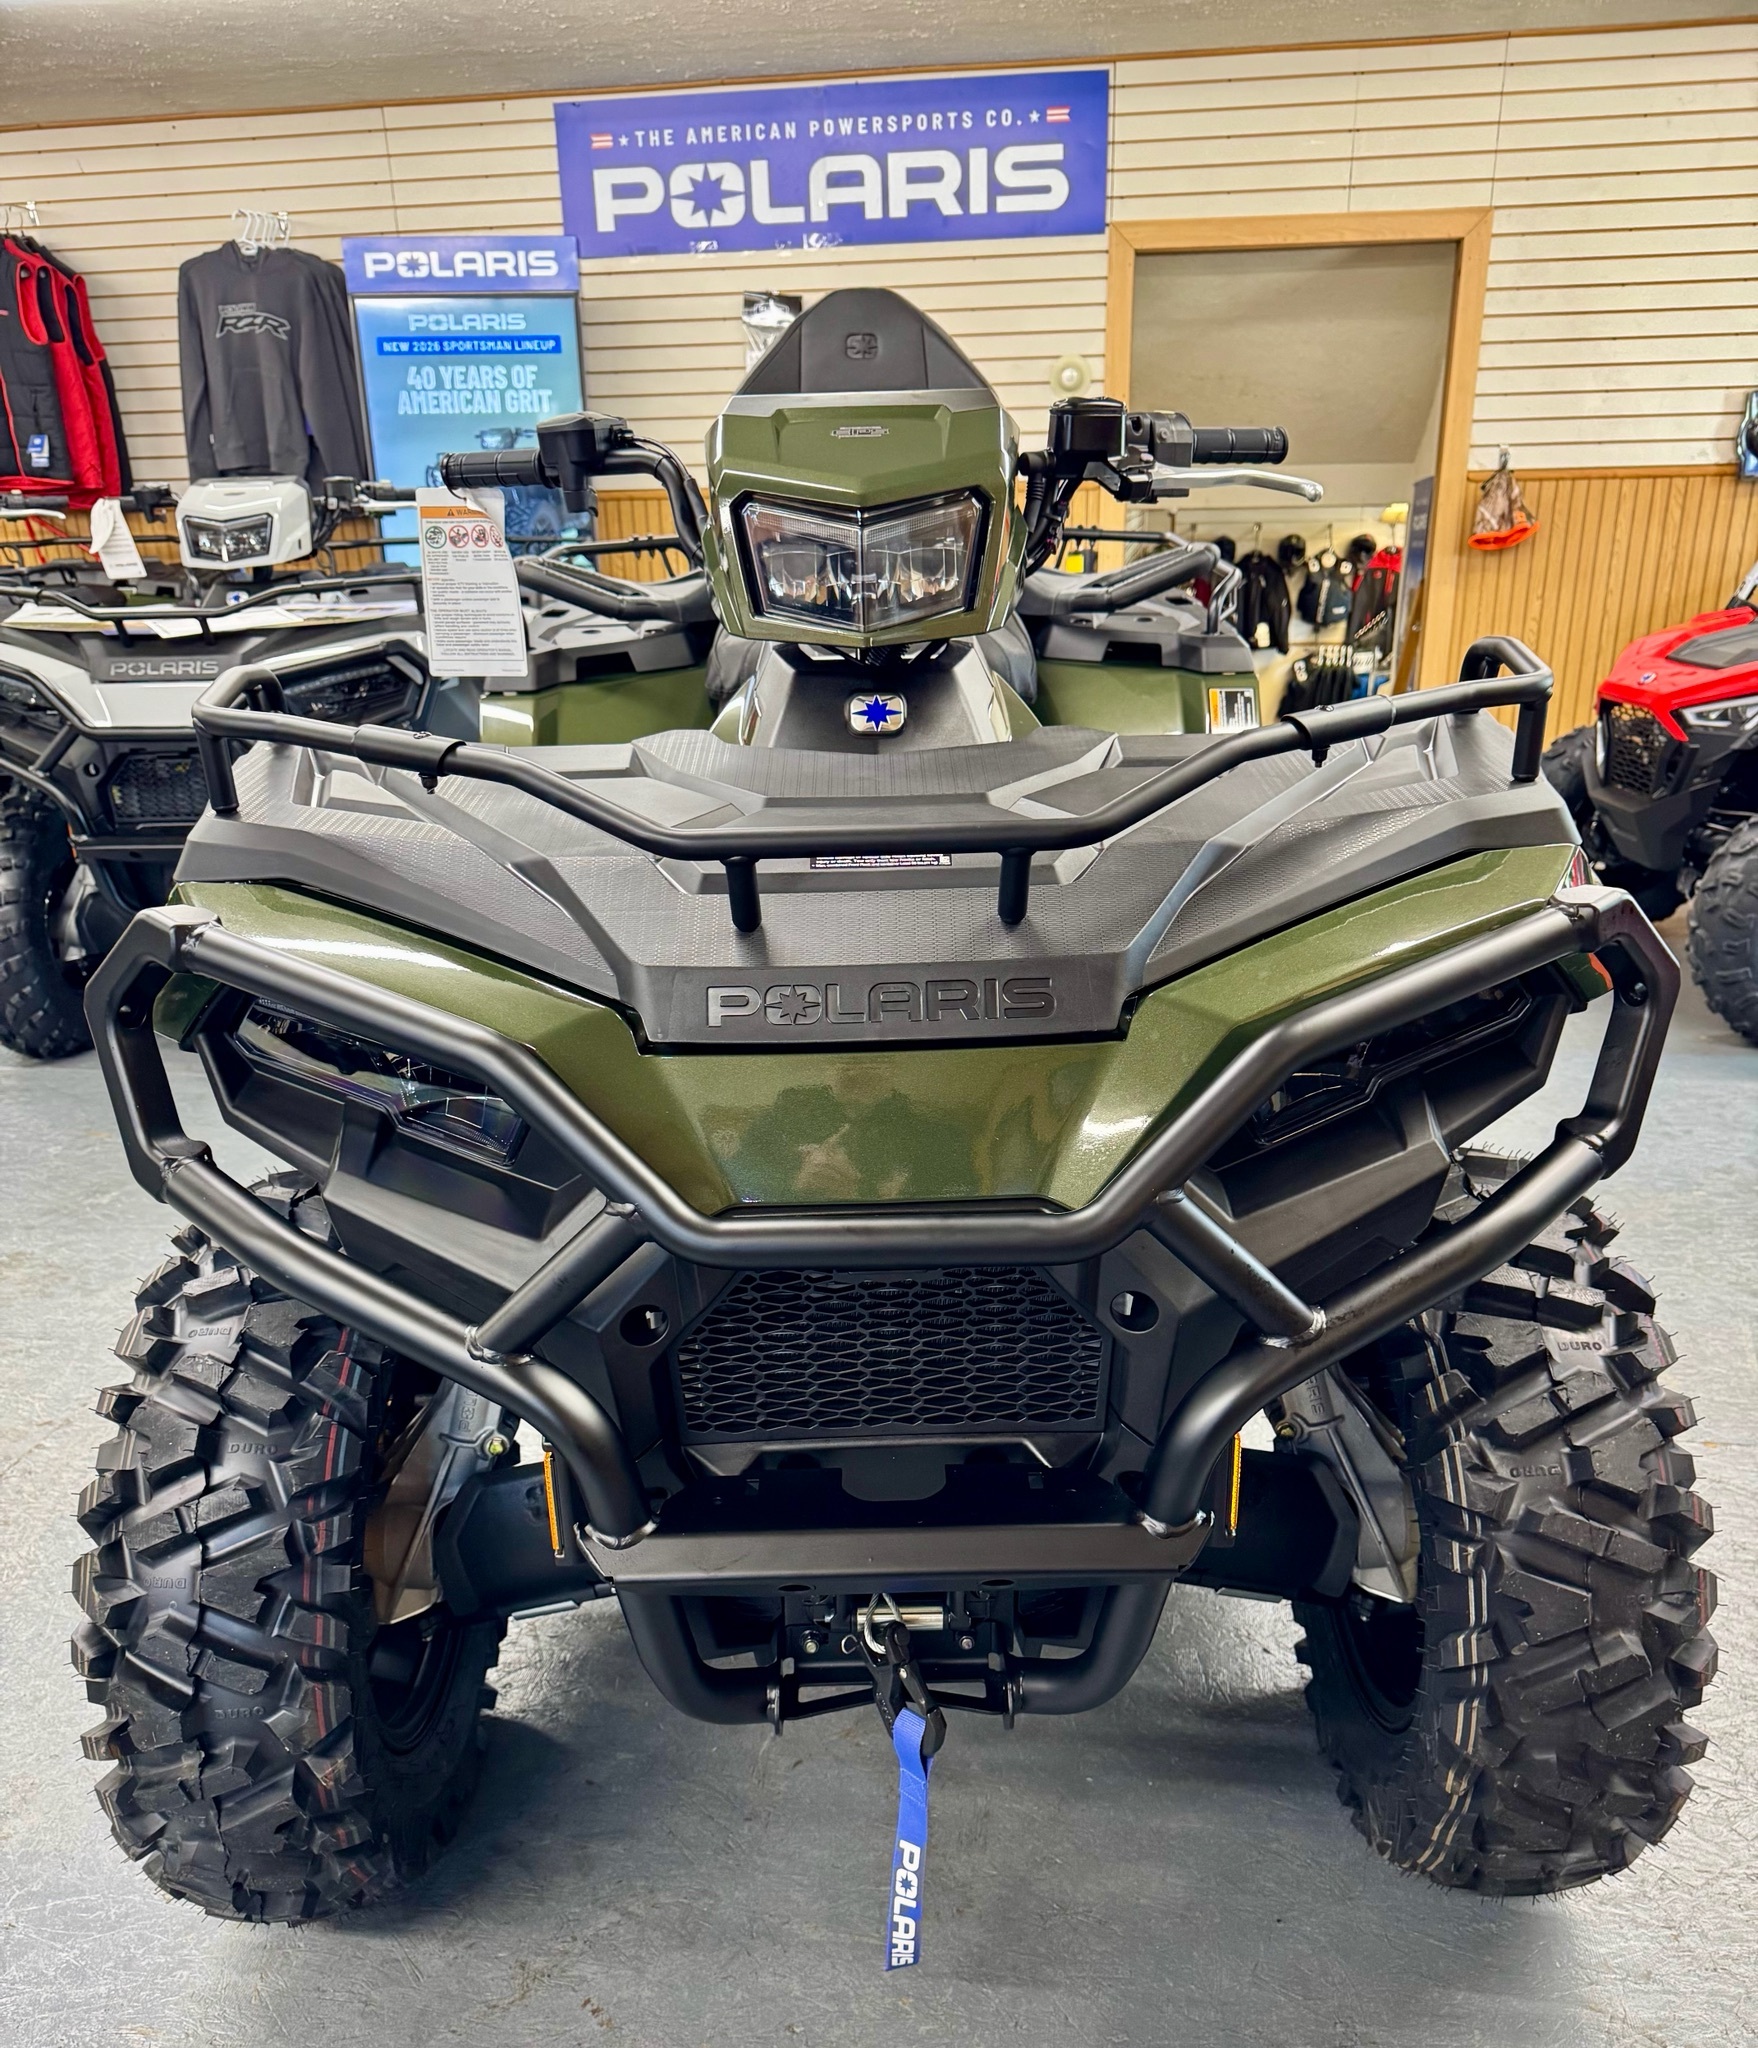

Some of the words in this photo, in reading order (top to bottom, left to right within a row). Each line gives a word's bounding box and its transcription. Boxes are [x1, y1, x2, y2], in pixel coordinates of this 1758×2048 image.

[634, 129, 675, 148] THE
[686, 121, 797, 145] AMERICAN
[809, 111, 973, 138] POWERSPORTS
[985, 108, 1023, 128] CO.
[592, 143, 1071, 232] POLARIS
[363, 250, 559, 279] POLARIS
[407, 313, 527, 331] POLARIS
[383, 341, 410, 353] NEW
[443, 340, 512, 352] SPORTSMAN
[514, 340, 556, 351] LINEUP
[406, 366, 436, 390] 40
[438, 365, 508, 390] YEARS
[511, 364, 538, 389] OF
[397, 389, 502, 415] AMERICAN
[504, 389, 552, 414] GRIT
[110, 660, 219, 676] POLARIS
[706, 977, 1057, 1028] POLARIS
[188, 1325, 232, 1338] DURO
[1556, 1340, 1602, 1352] DURO
[226, 1442, 278, 1457] DURO
[891, 1839, 921, 1967] POLARIS
